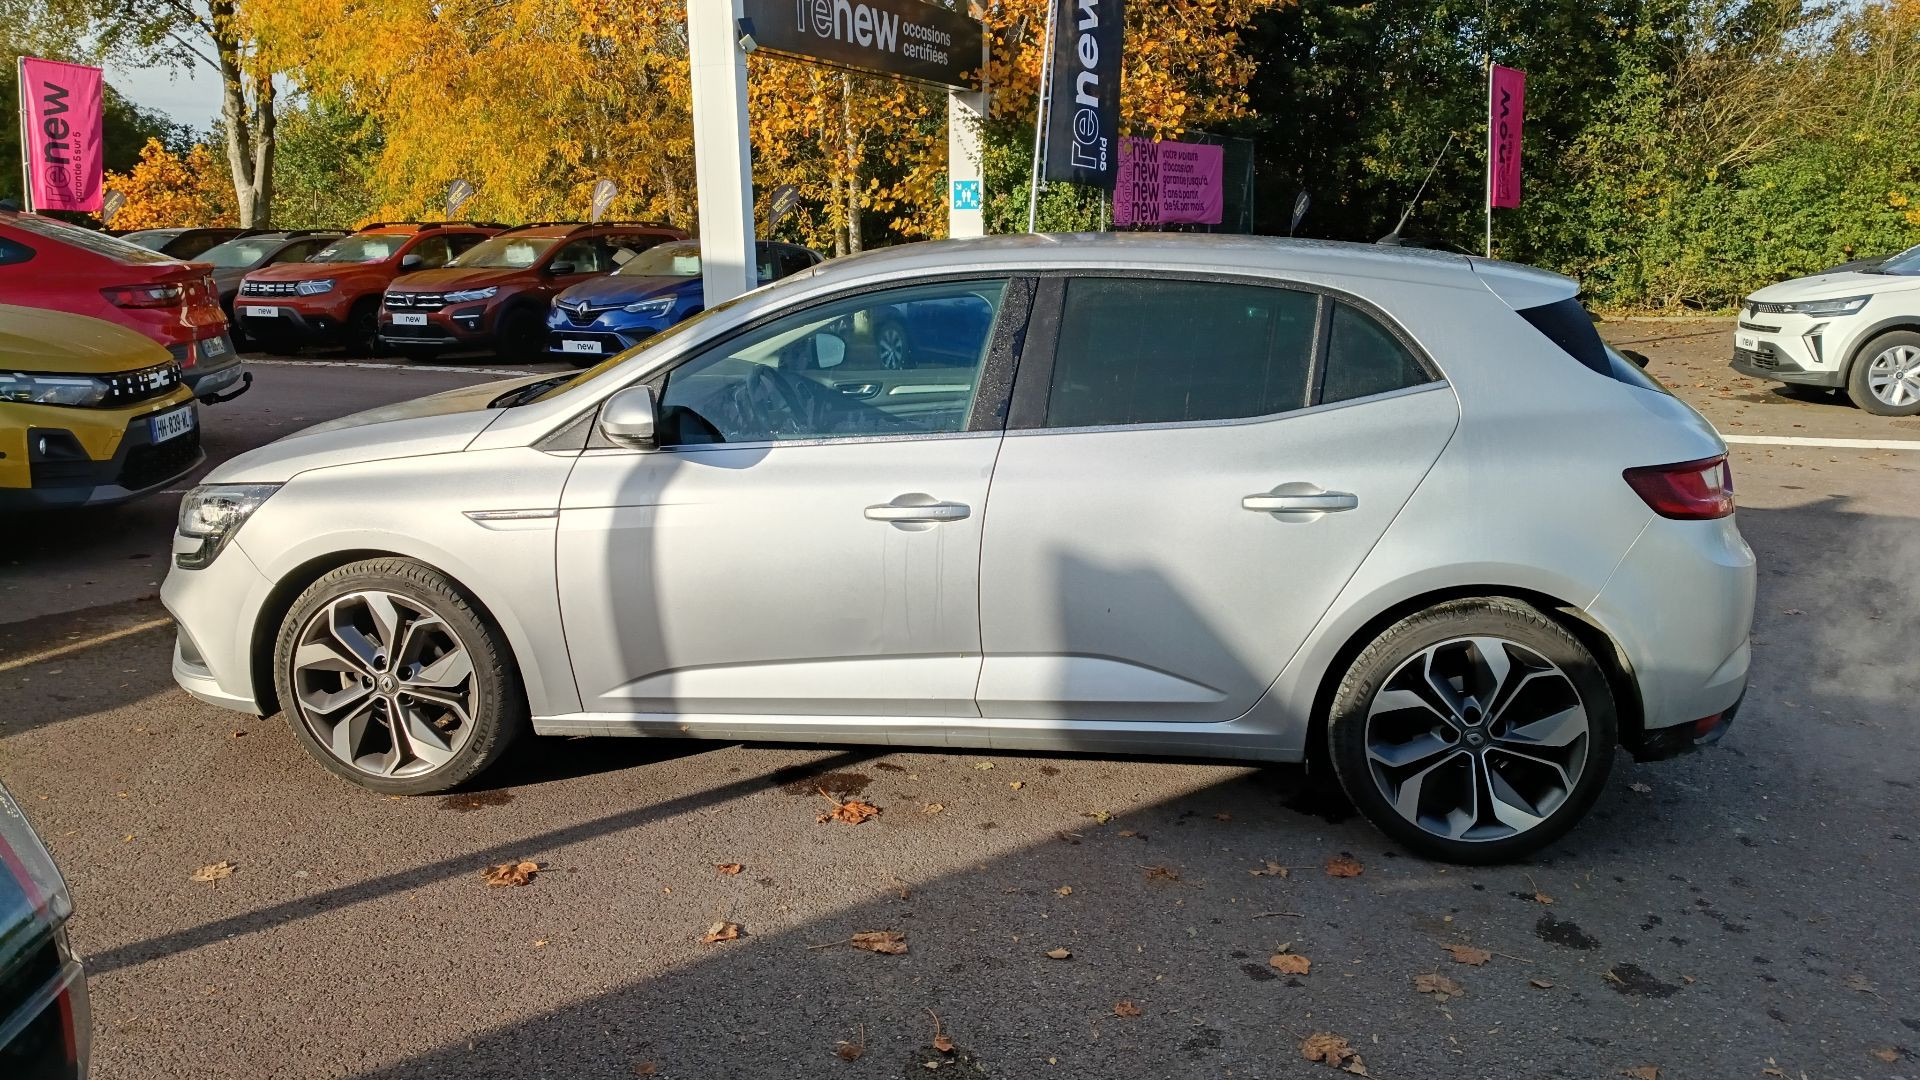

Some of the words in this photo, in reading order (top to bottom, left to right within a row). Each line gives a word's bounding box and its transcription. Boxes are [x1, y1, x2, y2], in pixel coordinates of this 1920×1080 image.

[796, 0, 899, 53] renew
[903, 22, 951, 47] occasions
[903, 43, 949, 66] certifiées
[43, 81, 71, 205] renew
[74, 139, 82, 155] sur
[1099, 136, 1108, 172] gold
[1162, 150, 1177, 160] votre
[1162, 161, 1194, 173] d'occasion
[1163, 199, 1173, 211] de
